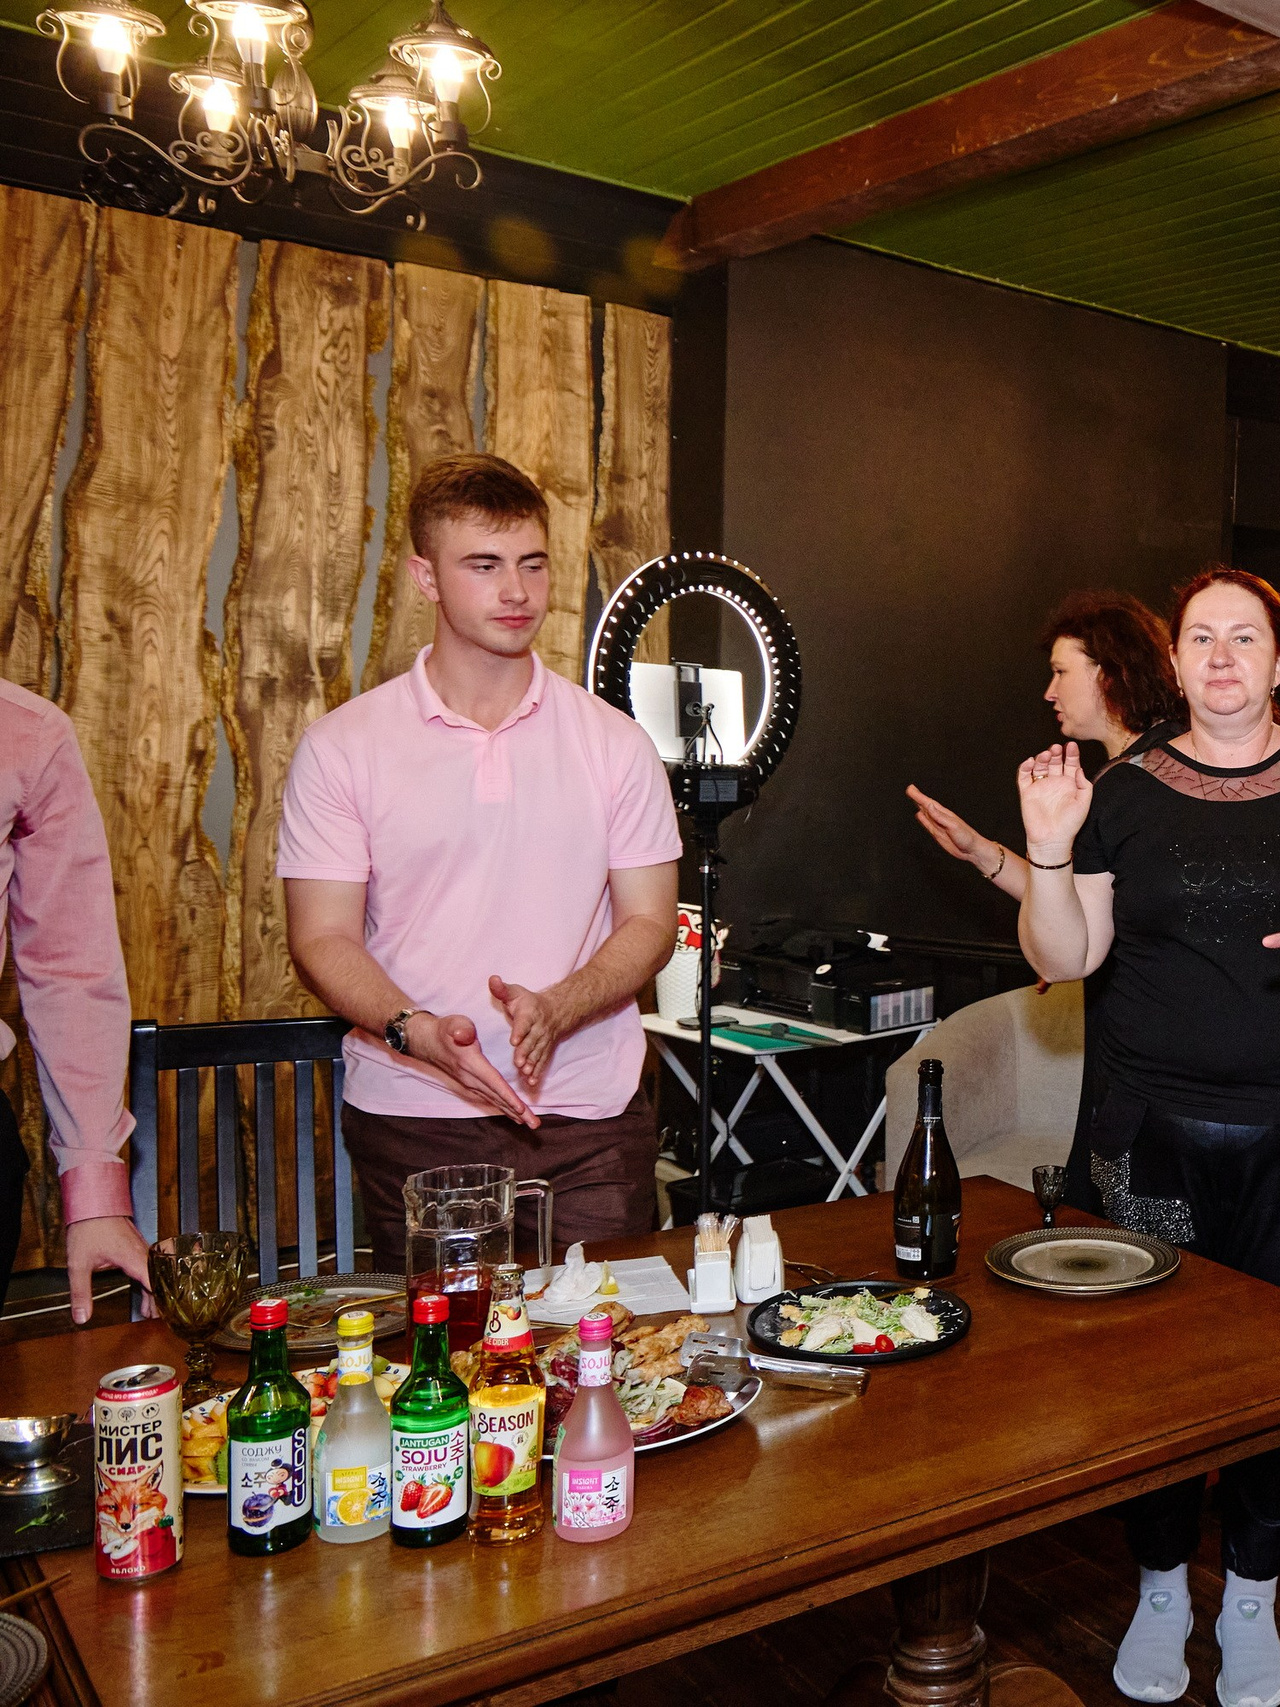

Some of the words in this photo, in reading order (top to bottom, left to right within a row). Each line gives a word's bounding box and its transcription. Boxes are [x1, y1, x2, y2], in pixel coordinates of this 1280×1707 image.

[493, 1338, 509, 1346] CIDER
[340, 1353, 370, 1368] SOJU
[581, 1355, 610, 1370] SOJU
[98, 1420, 162, 1436] МИСТЕР
[477, 1409, 534, 1434] SEASON
[97, 1433, 162, 1465] ЛИС
[401, 1435, 449, 1448] JANTUGAN
[450, 1430, 465, 1466] 소주
[241, 1445, 282, 1457] СОДЖУ
[401, 1447, 448, 1465] SOJU
[108, 1465, 147, 1476] СИДР
[294, 1427, 306, 1505] SOJU
[401, 1463, 448, 1472] STRAWBERRY
[241, 1472, 267, 1488] 소주
[571, 1477, 599, 1486] INSIGHT
[604, 1476, 620, 1513] 소주
[111, 1566, 146, 1575] ЯБЛОКО
